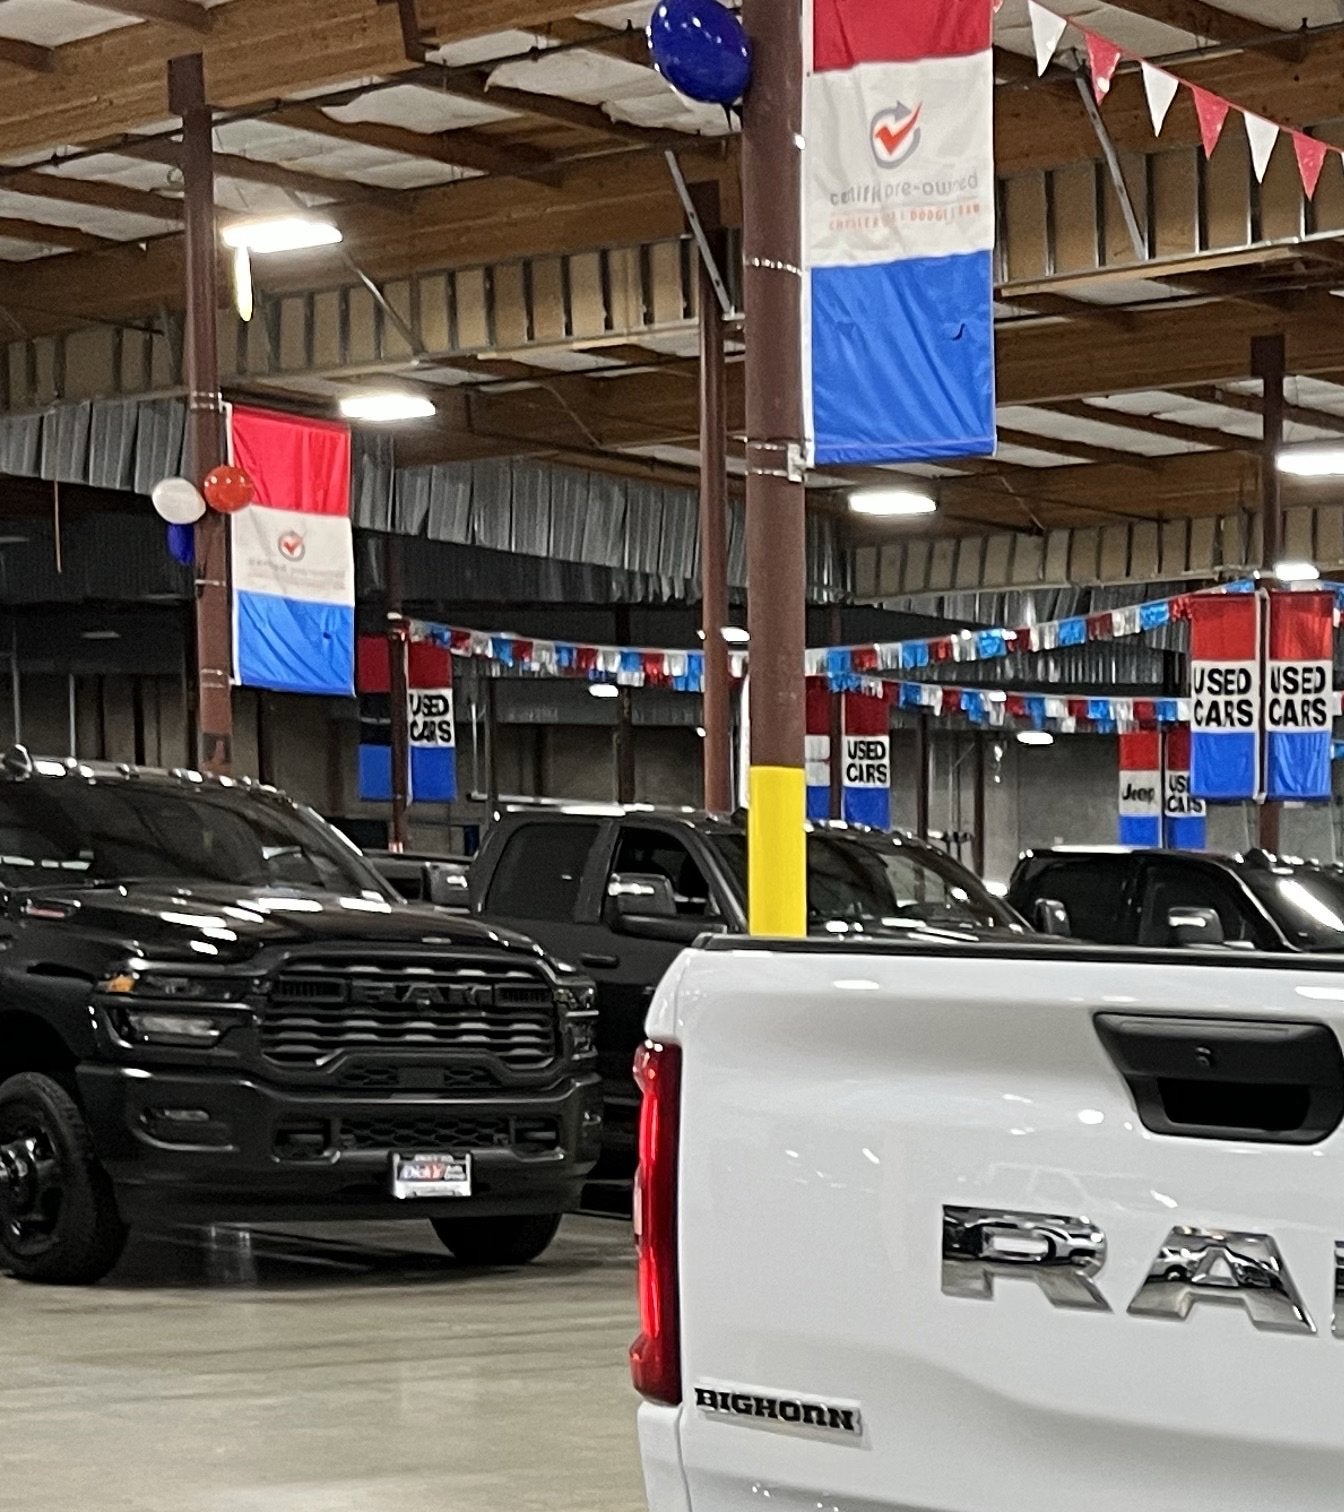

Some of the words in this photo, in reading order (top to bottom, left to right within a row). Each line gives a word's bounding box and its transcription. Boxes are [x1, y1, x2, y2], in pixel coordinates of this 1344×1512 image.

[1193, 667, 1252, 696] USED
[1270, 665, 1326, 695] USED
[409, 694, 450, 717] USED
[1193, 699, 1254, 728] CARS
[1269, 698, 1327, 727] CARS
[410, 720, 452, 743] CARS
[847, 740, 886, 761] USED
[846, 763, 887, 784] CARS
[1169, 775, 1190, 793] US
[1122, 783, 1155, 803] Jeep
[350, 981, 493, 1006] RAM
[694, 1387, 858, 1434] BIGHORN
